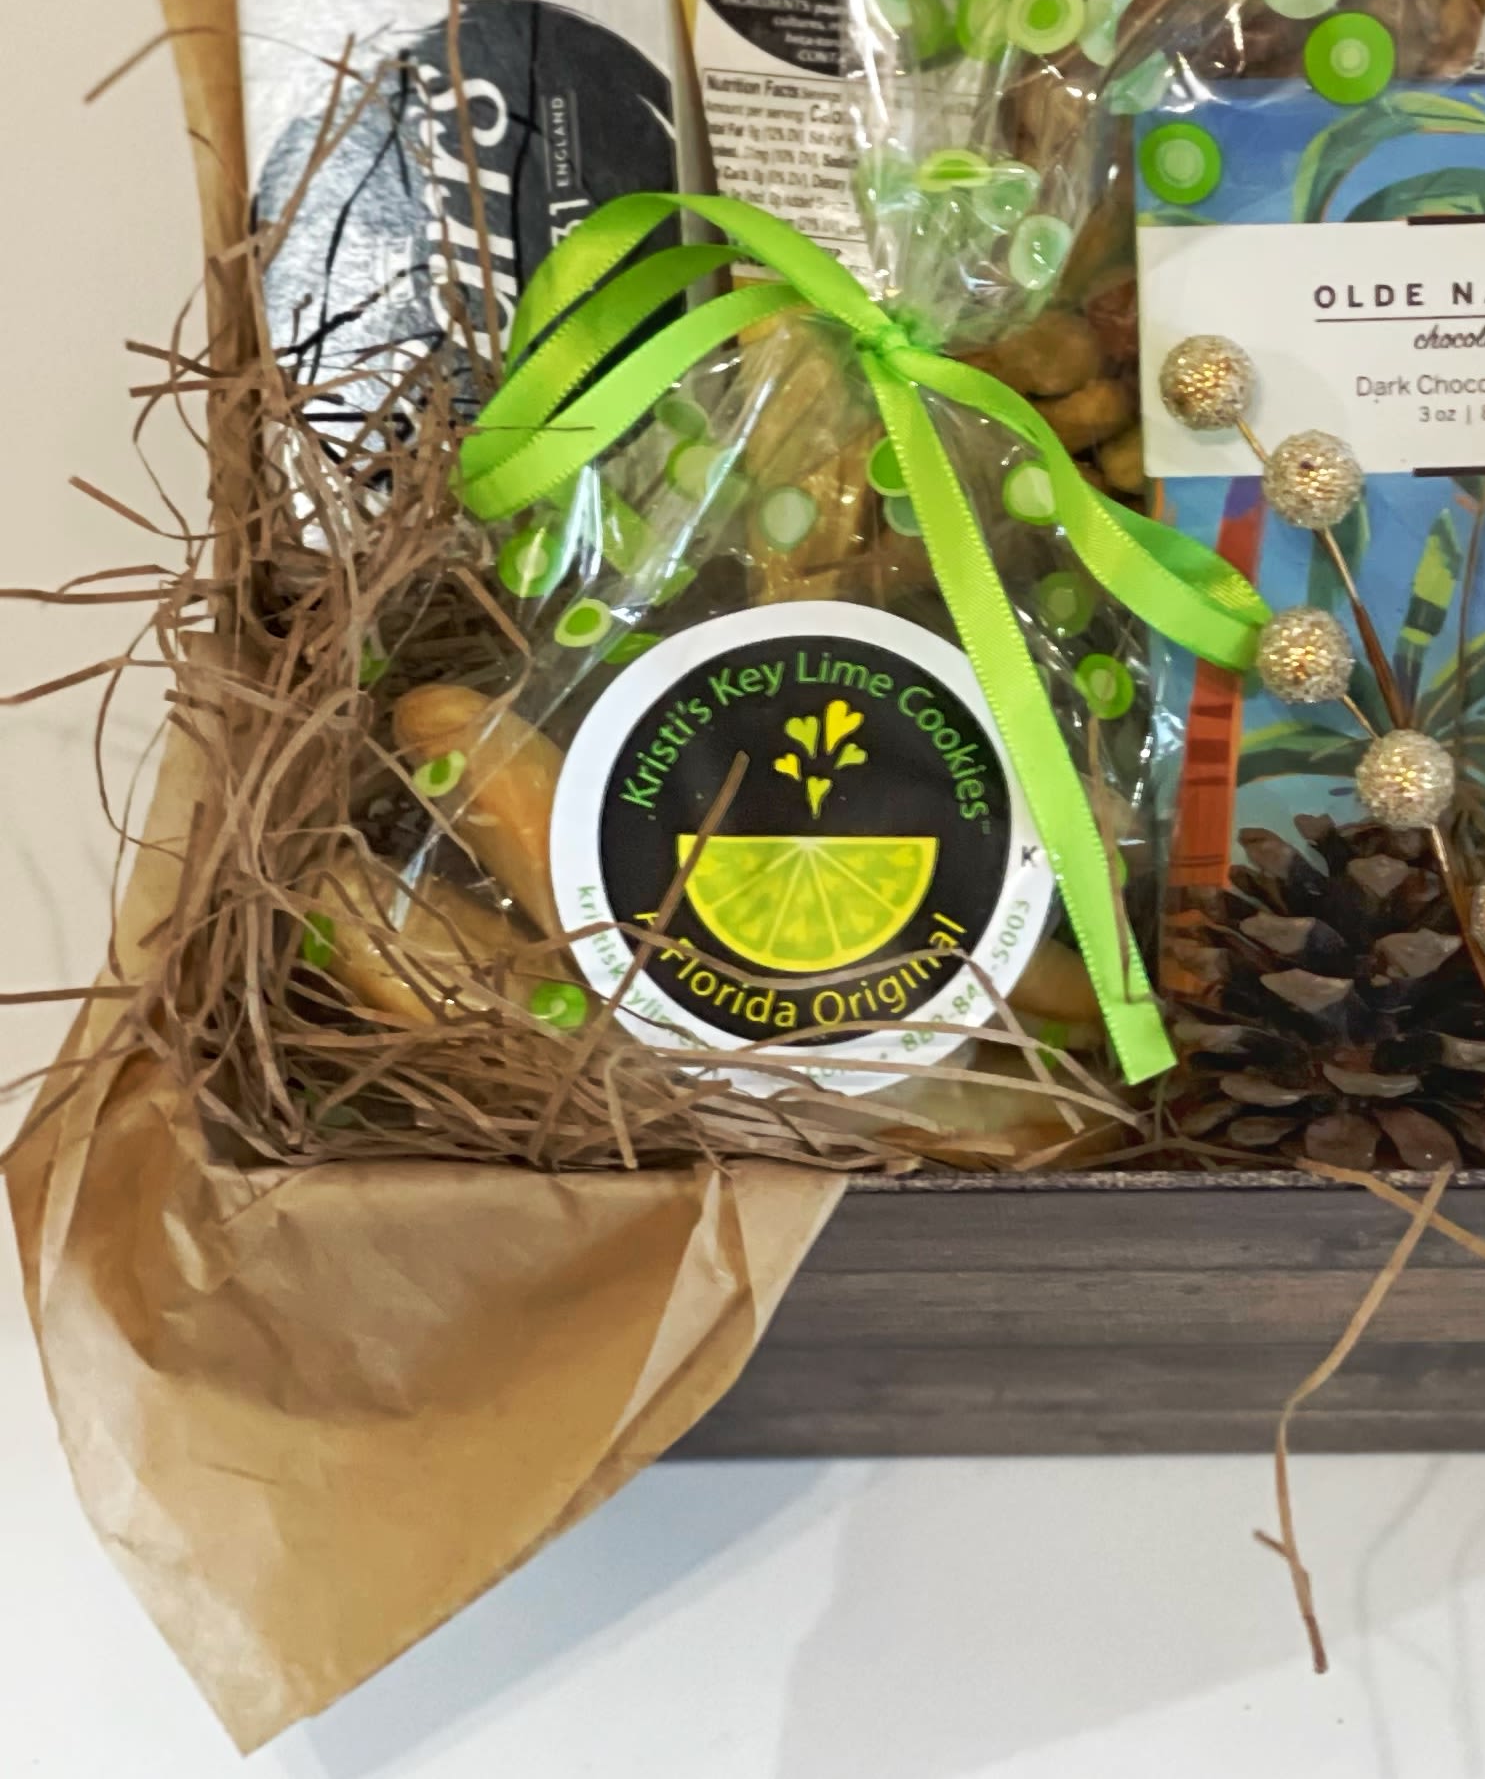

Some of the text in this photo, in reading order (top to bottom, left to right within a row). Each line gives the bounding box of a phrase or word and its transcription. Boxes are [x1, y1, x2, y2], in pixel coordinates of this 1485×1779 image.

[550, 96, 570, 189] ENGLAND
[1313, 282, 1426, 308] OLDE
[1355, 373, 1411, 398] Dark
[1418, 405, 1431, 423] 3
[1434, 408, 1457, 423] oz
[619, 697, 713, 810] Kristi's
[708, 660, 787, 706] Key
[795, 651, 895, 700] Lime
[812, 912, 968, 1027] Original
